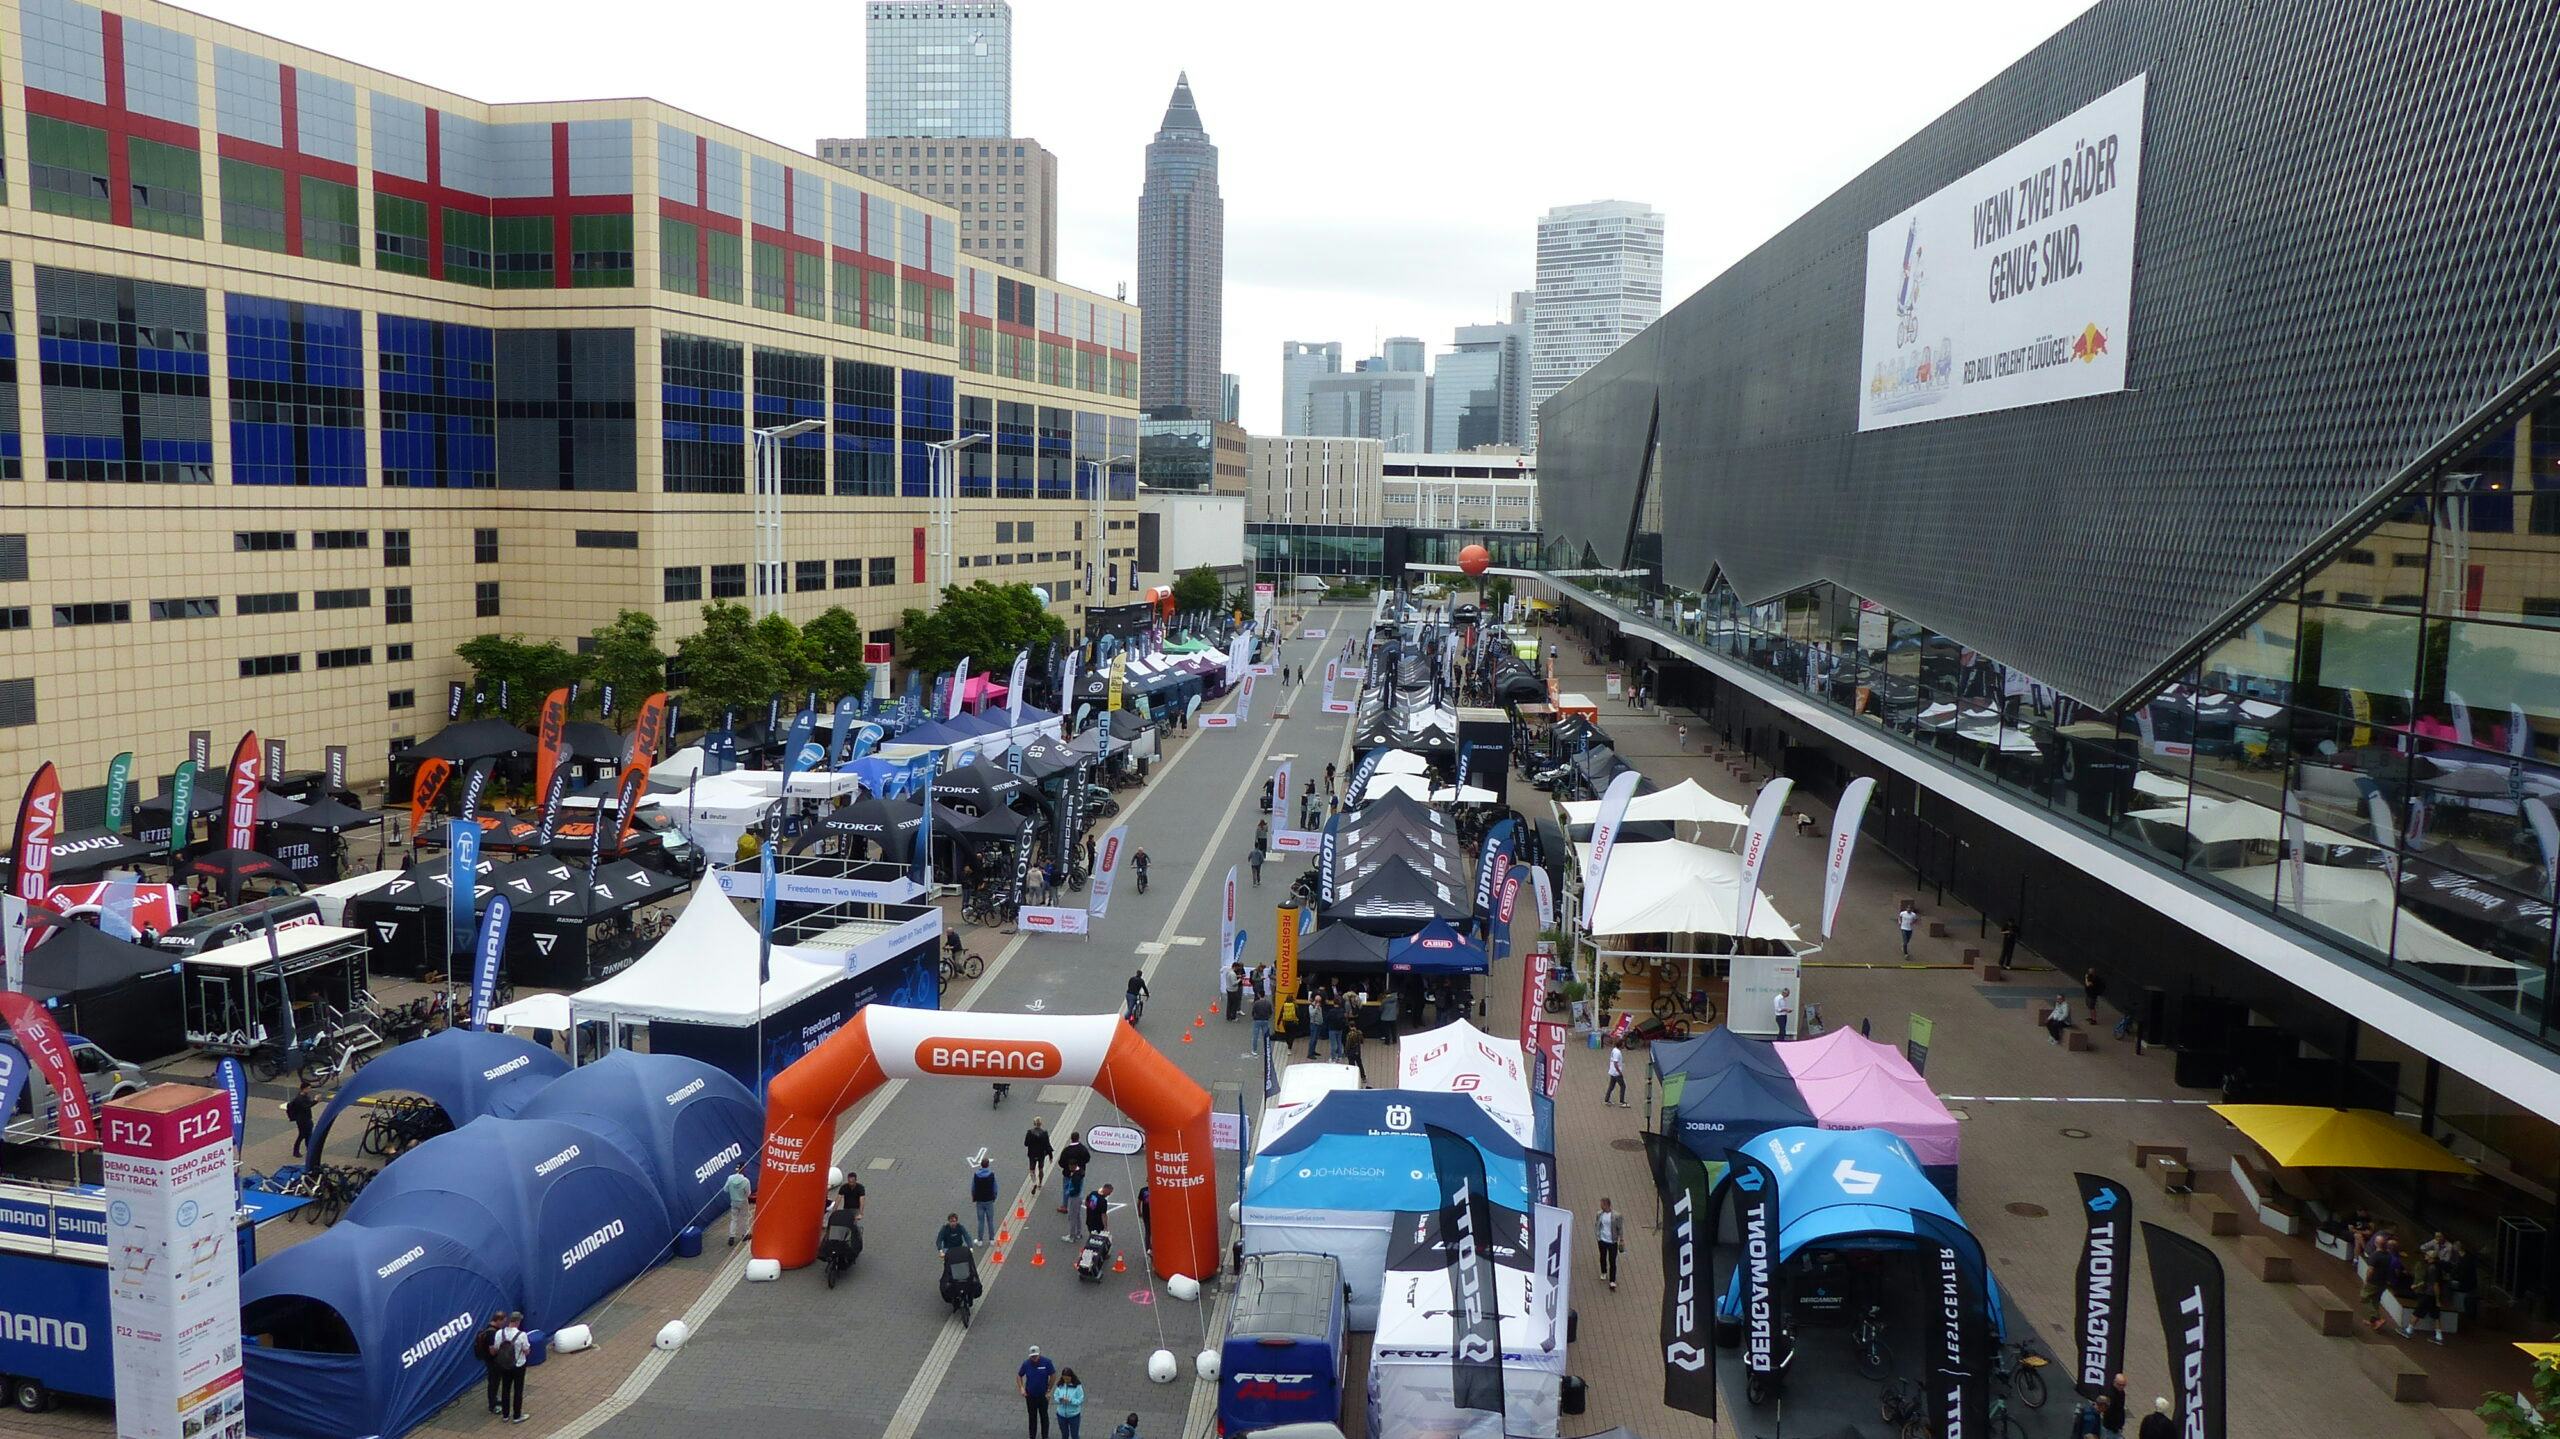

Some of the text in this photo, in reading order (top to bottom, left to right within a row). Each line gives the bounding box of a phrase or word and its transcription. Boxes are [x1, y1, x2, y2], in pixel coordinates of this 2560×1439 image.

[1973, 133, 2118, 250] WENN ZWEI RÄDER
[1989, 223, 2082, 304] GENUG SIND.
[1963, 360, 1976, 384] RED
[1976, 355, 1993, 381] BULL
[1994, 346, 2026, 377] VERLEIHT
[545, 702, 564, 752] KTM
[895, 695, 906, 738] TUNAP
[638, 704, 661, 757] KTM
[111, 764, 127, 817] owuru
[417, 764, 448, 809] KTM
[931, 785, 980, 794] STORCK
[992, 779, 1021, 792] STORCK
[1344, 757, 1375, 806] pinion
[175, 772, 191, 826] owuru
[232, 758, 257, 850] SENA
[545, 776, 564, 835] RAYMON
[826, 821, 883, 831] STORCK
[23, 792, 56, 901] SENA
[51, 835, 120, 856] owuru
[278, 844, 310, 859] BETTER
[1594, 825, 1610, 861] BOSCH
[1746, 832, 1762, 867] BOSCH
[1834, 833, 1848, 868] BOSCH
[291, 856, 319, 870] RIDES
[1014, 819, 1034, 904] STORCK
[1322, 832, 1334, 904] pinion
[1476, 837, 1502, 910] pinion
[787, 883, 820, 894] Freedom
[833, 887, 849, 896] Two
[851, 889, 878, 898] Wheels
[1502, 881, 1516, 917] ABUS
[159, 936, 195, 946] SENA
[1281, 914, 1291, 987] REGISTRATION
[475, 902, 504, 1026] SHIMANO
[802, 1011, 840, 1038] Freedom on
[802, 1037, 817, 1053] Two
[483, 1054, 530, 1081] SHIMANO
[932, 1047, 1044, 1071] BAFANG
[666, 1078, 705, 1105] SHIMANO
[111, 1119, 152, 1147] F12
[179, 1109, 221, 1143] F12
[1114, 1132, 1137, 1140] PLEASE
[1685, 1122, 1725, 1131] JOBRAD
[767, 1146, 800, 1161] DRIVE
[769, 1133, 803, 1148] E-BIKE
[1091, 1139, 1121, 1148] LANGSAM
[105, 1160, 130, 1173] DEMO
[133, 1165, 157, 1176] AREA
[171, 1158, 198, 1175] DEMO
[201, 1148, 225, 1164] AREA
[534, 1144, 580, 1177] SHIMANO
[695, 1142, 742, 1184] SHIMANO
[766, 1158, 816, 1175] SYSTEMS
[1154, 1151, 1189, 1162] E-BIKE
[1155, 1164, 1188, 1175] DRIVE
[105, 1171, 126, 1184] TEST
[128, 1174, 158, 1187] TRACK
[171, 1171, 195, 1187] TEST
[195, 1160, 227, 1178] TRACK
[1156, 1175, 1205, 1187] SYSTEMS
[1313, 1167, 1385, 1178] JOHANSSON
[561, 1219, 624, 1271] SHIMANO
[378, 1245, 425, 1279] SHIMANO
[117, 1326, 132, 1338] F12
[401, 1312, 473, 1369] SHIMANO
[1379, 1349, 1448, 1359] FELT
[1234, 1372, 1313, 1383] FELT
